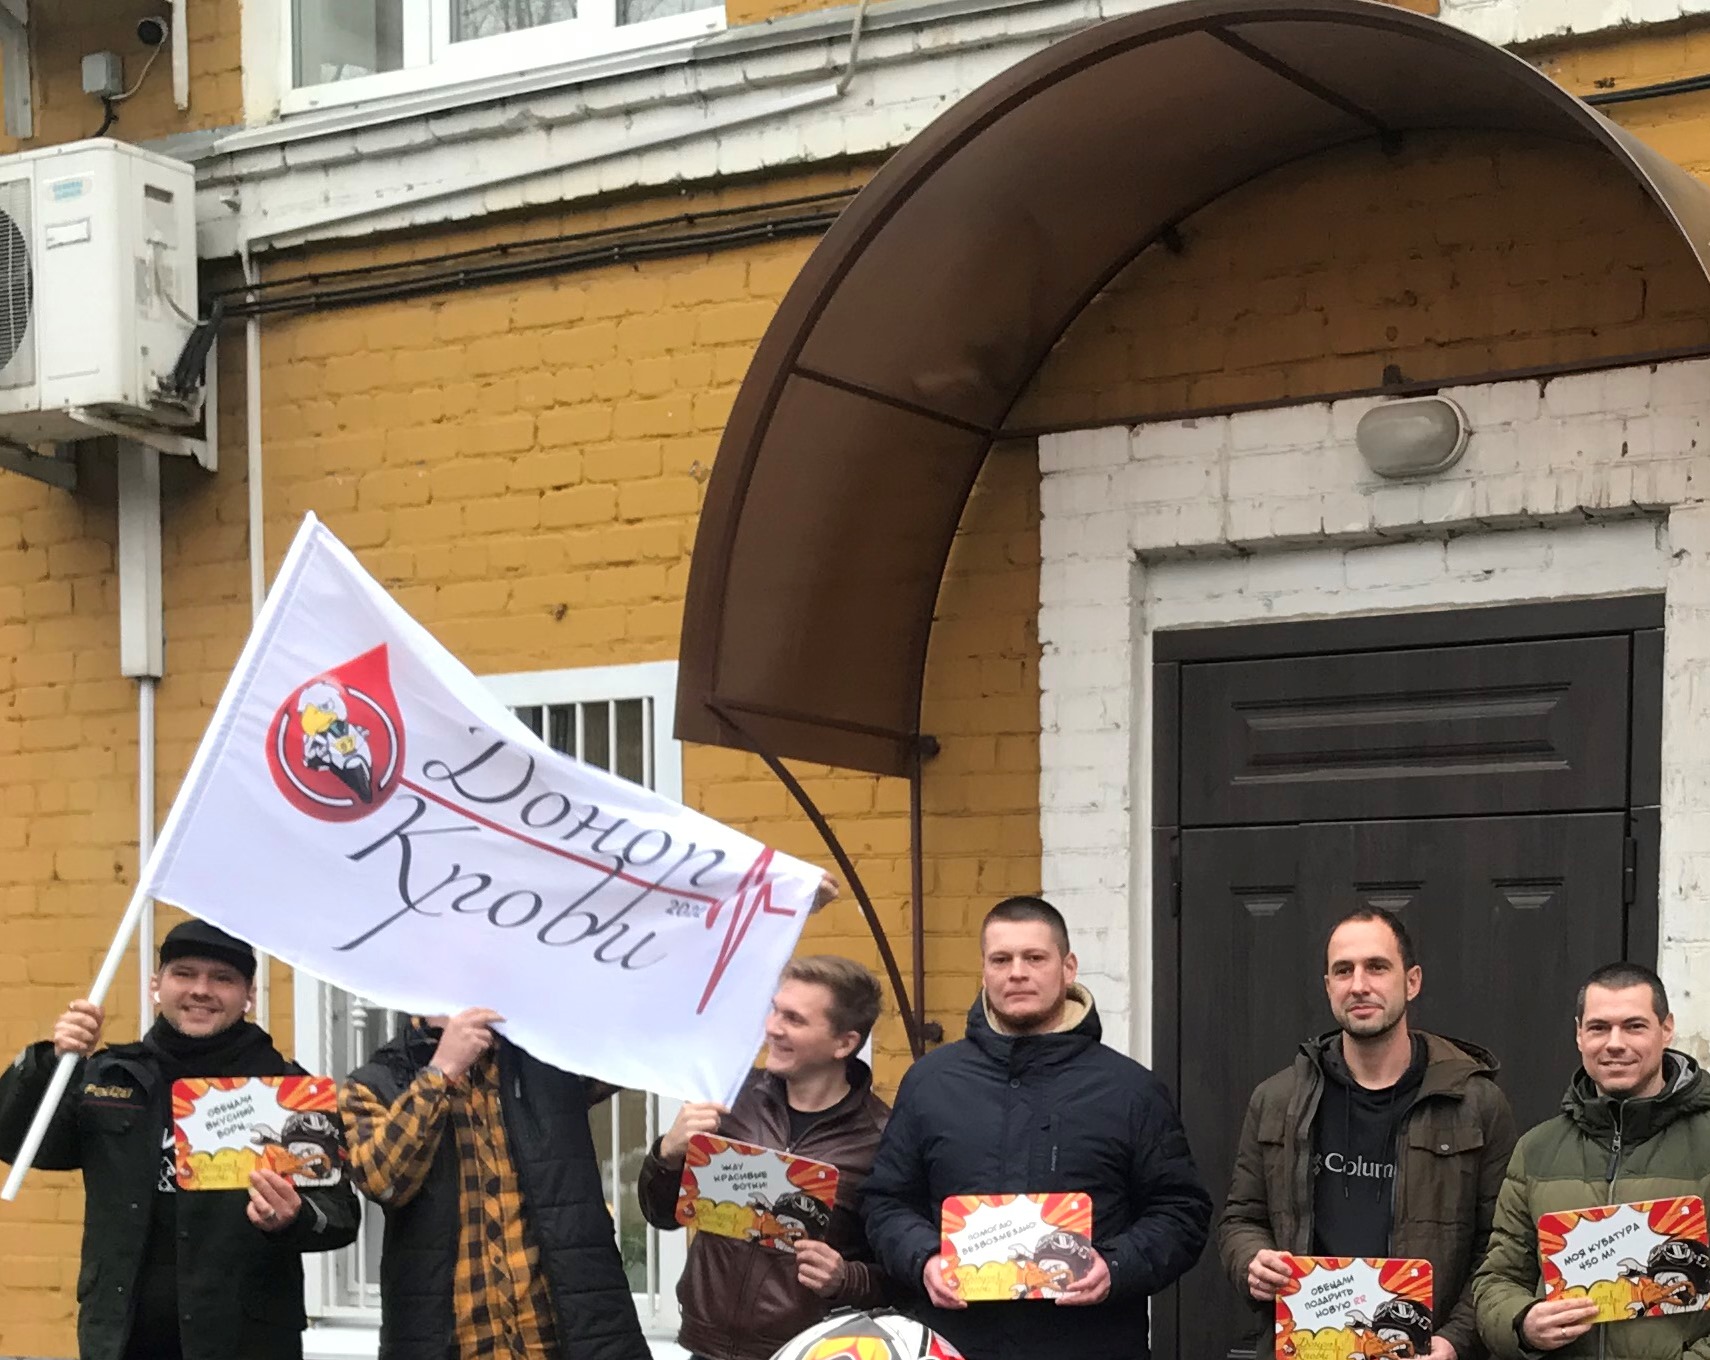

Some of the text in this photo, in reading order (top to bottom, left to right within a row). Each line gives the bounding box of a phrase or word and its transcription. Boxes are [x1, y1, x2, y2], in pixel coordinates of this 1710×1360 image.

[423, 726, 725, 928] Донор
[332, 795, 668, 969] Крови
[1325, 1152, 1395, 1179] Colum
[1563, 1222, 1641, 1266] МОЯ КУБАТУРА
[1578, 1248, 1616, 1271] 450 МЛ
[1310, 1274, 1354, 1297] ОБЕЩАЛИ
[1304, 1288, 1354, 1310] ПОДАРИТЬ
[1315, 1300, 1351, 1319] НОВУЮ
